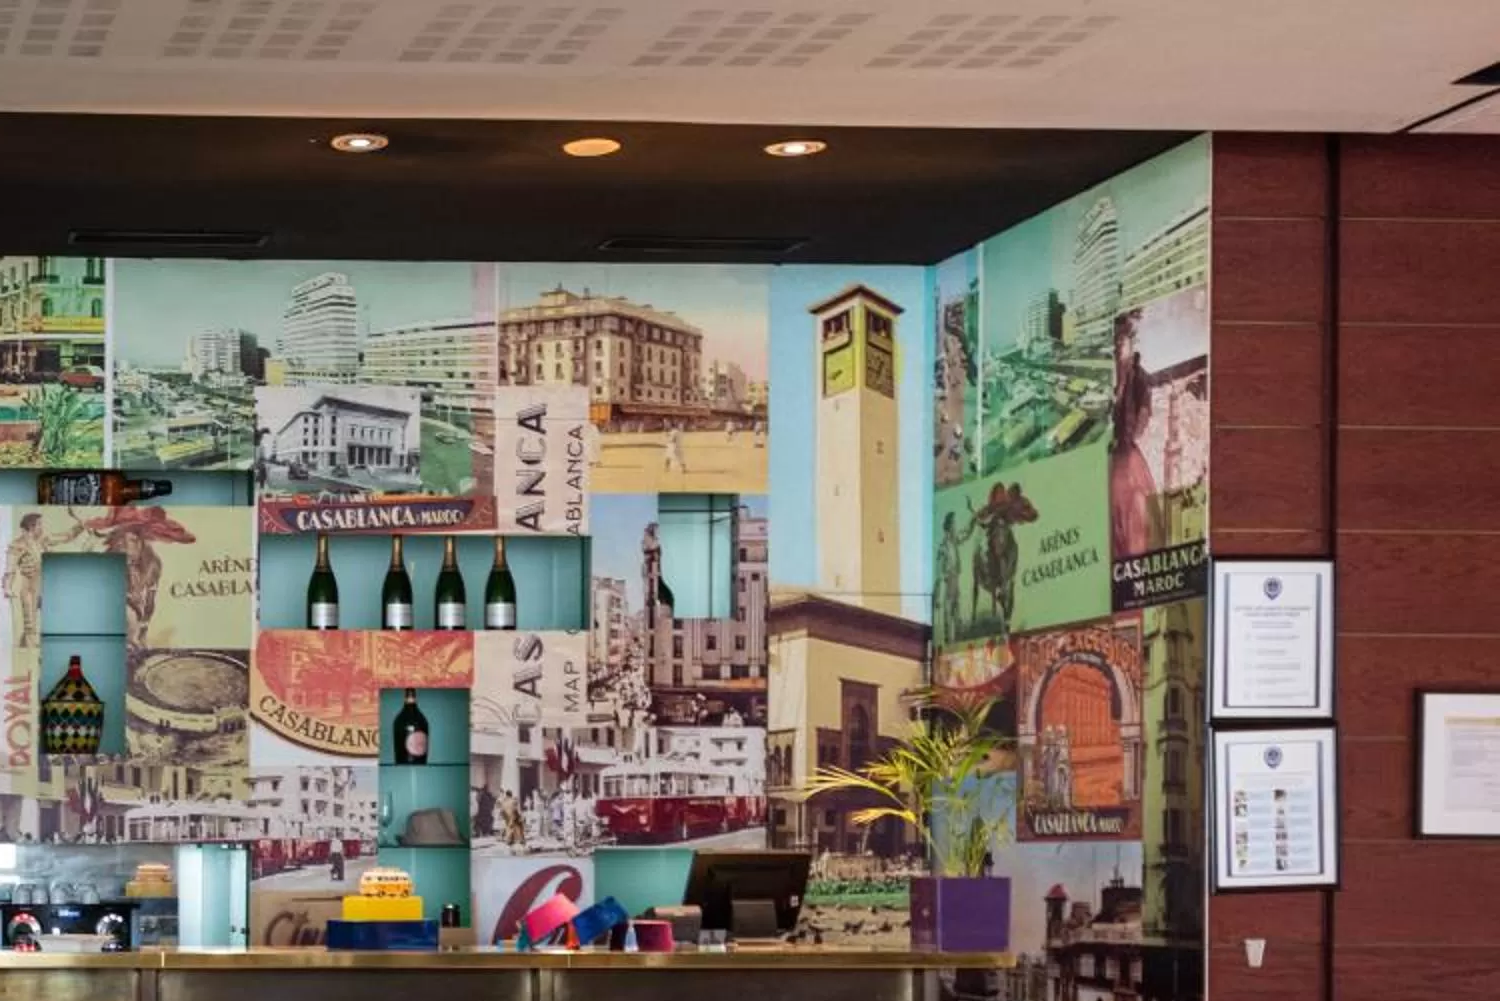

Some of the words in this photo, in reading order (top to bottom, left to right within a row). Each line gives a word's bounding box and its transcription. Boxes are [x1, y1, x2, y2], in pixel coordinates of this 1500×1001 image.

[516, 403, 547, 533] ANCA
[297, 506, 417, 531] CASABLANCA
[1022, 546, 1100, 587] CASABLANCA
[1133, 572, 1185, 598] MAROC
[170, 578, 254, 598] CASABLA
[513, 634, 544, 728] CAS
[564, 660, 581, 713] MAP
